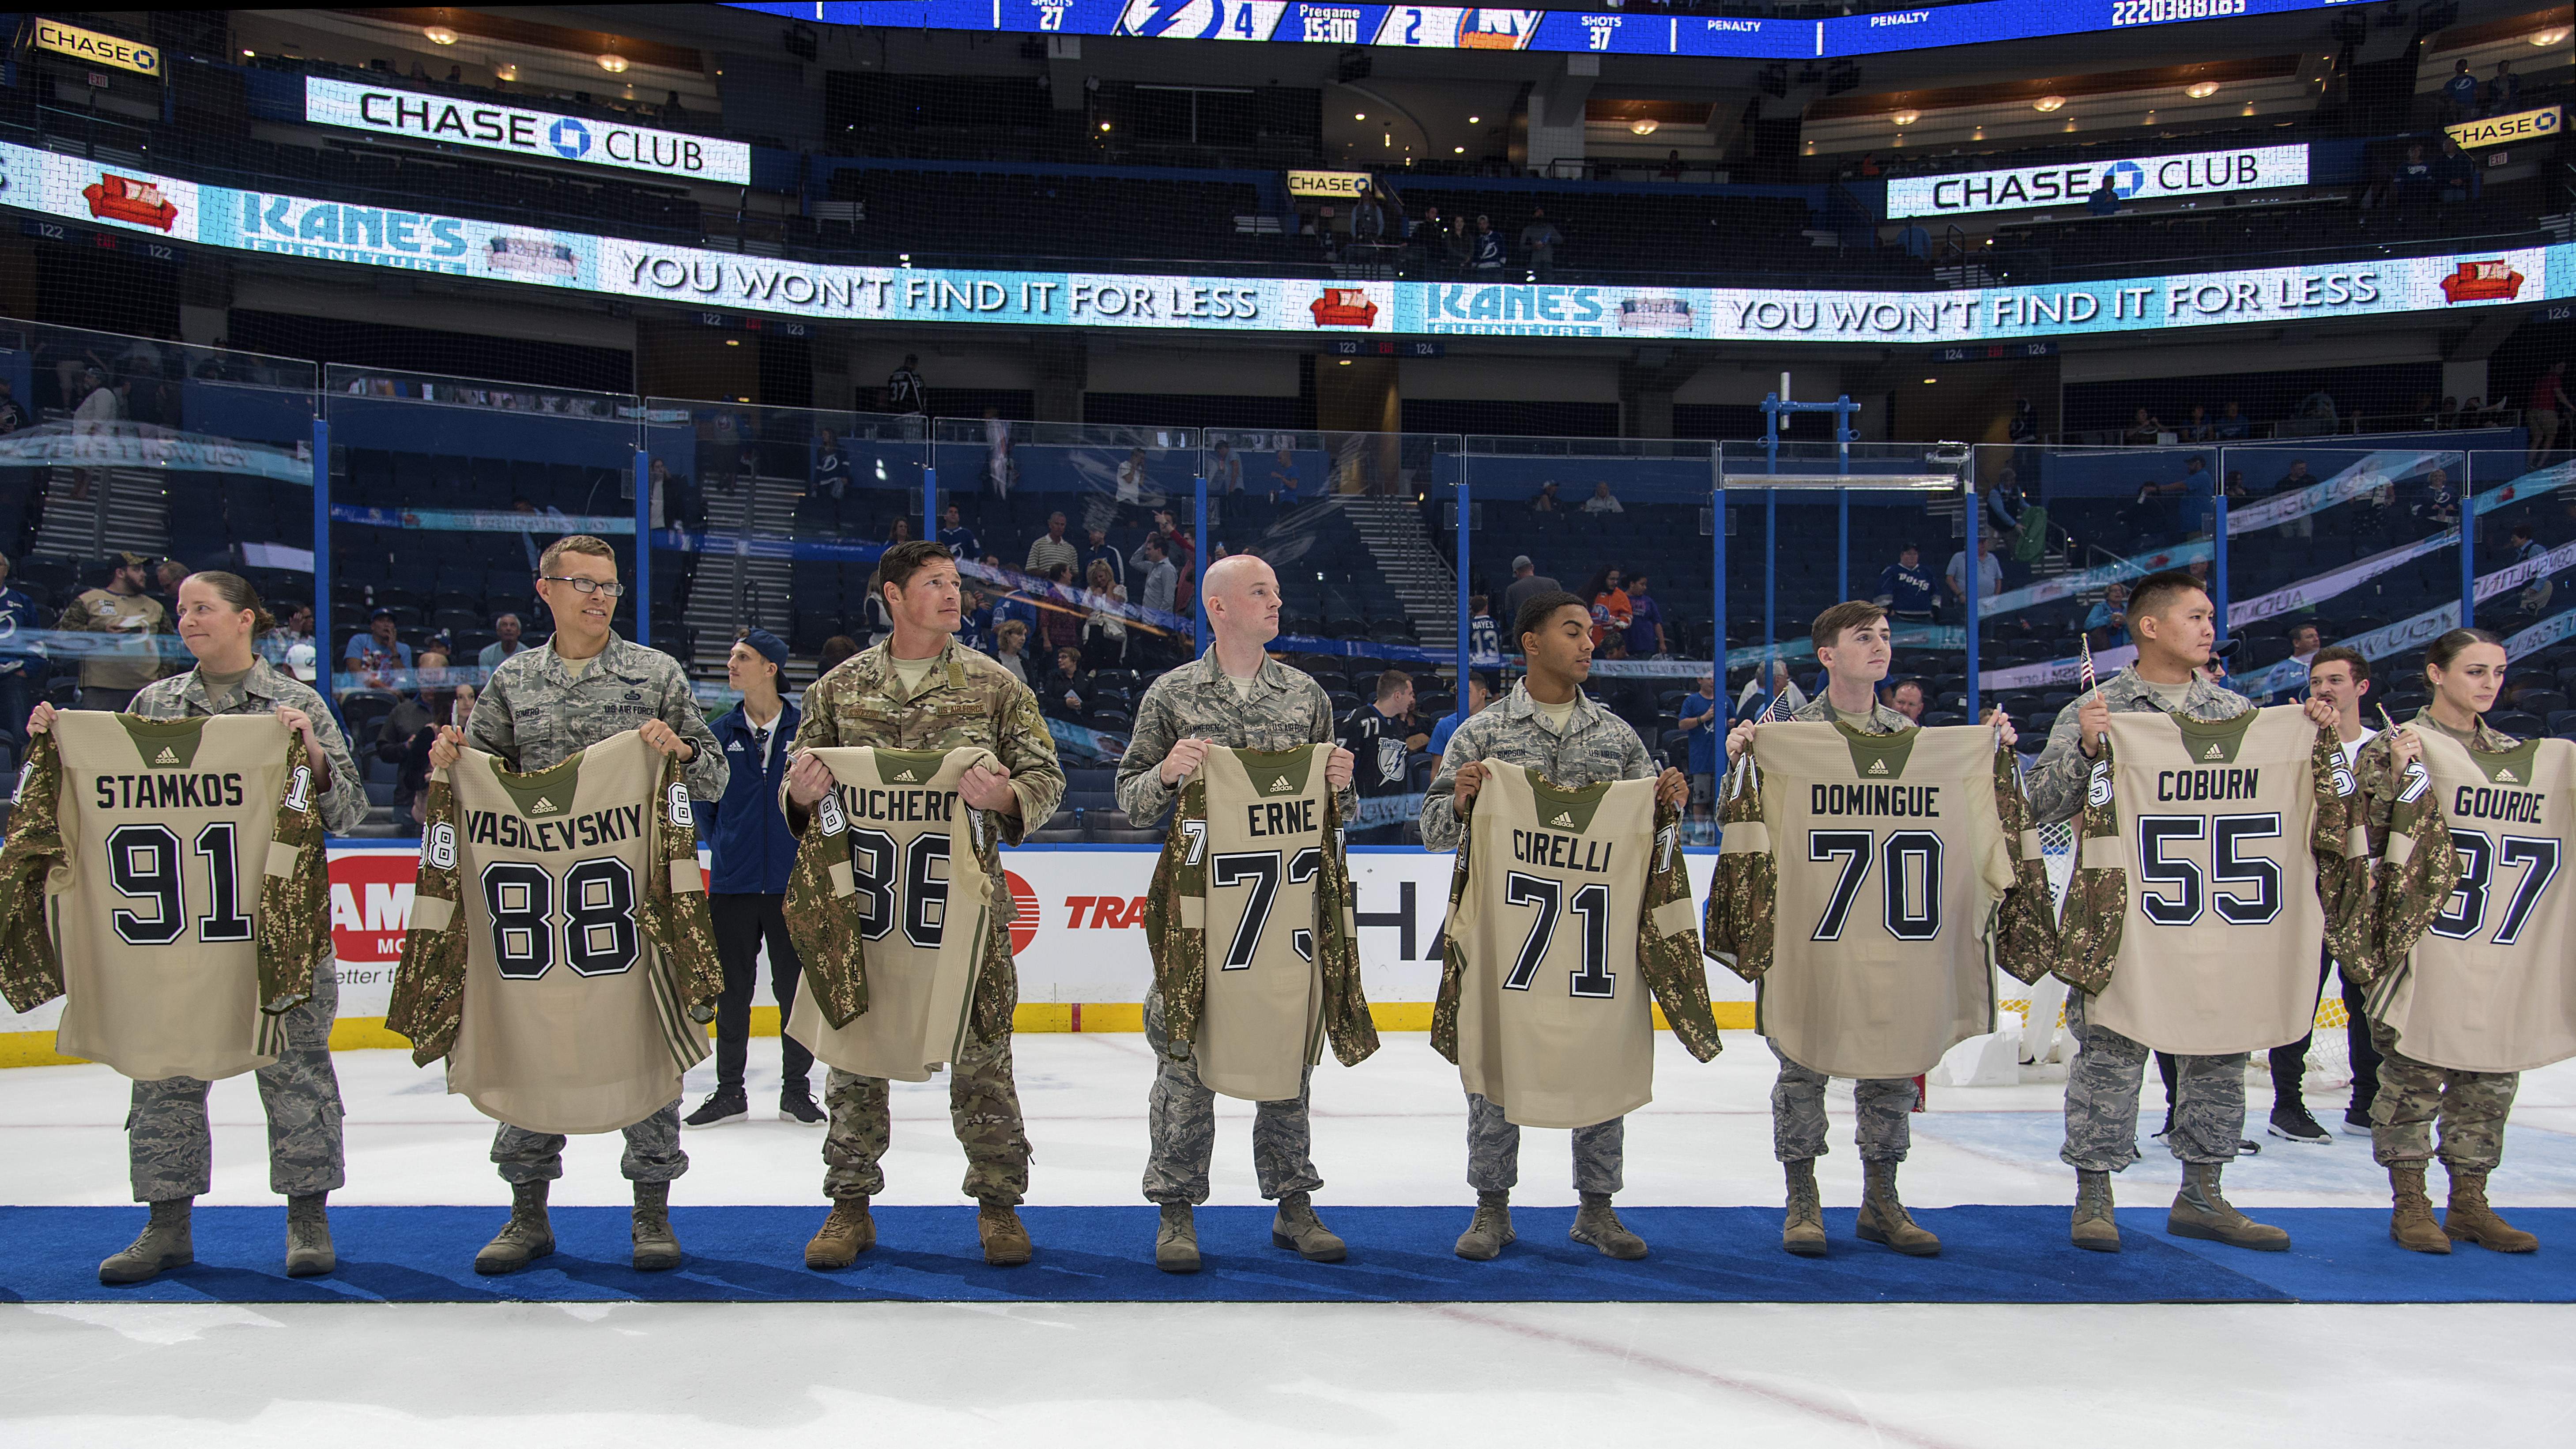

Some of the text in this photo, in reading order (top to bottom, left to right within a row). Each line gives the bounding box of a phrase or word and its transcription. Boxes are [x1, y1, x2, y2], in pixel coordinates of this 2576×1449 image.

[1040, 6, 1064, 30] 27
[1235, 2, 1253, 38] 4
[1300, 4, 1360, 20] Pregame
[1406, 8, 1421, 44] 2
[1581, 16, 1622, 26] SHOTS
[1708, 20, 1761, 32] PENALTY
[1871, 11, 1929, 27] PENALTY
[1303, 17, 1357, 43] 15:00
[1479, 9, 1537, 49] NY
[1589, 26, 1611, 50] 37
[40, 27, 130, 63] CHASE
[91, 74, 107, 87] EXIT
[361, 92, 702, 171] CHASE CLUB
[2491, 154, 2506, 166] EXIT
[1290, 177, 1352, 191] CHASE
[1934, 155, 2257, 209] CHASE CLUB
[39, 223, 63, 238] 122
[244, 192, 467, 257] KANE'S
[151, 245, 171, 260] 122
[253, 240, 460, 275] FURNITURE
[622, 254, 1257, 318] YOU WON'T FIND IT FOR LESS
[1428, 284, 1603, 321] KANE'S
[1733, 272, 2378, 331] YOU WON'T FIND IT FOR LESS
[2547, 307, 2570, 320] 126
[703, 313, 721, 326] 122
[786, 323, 804, 336] 123
[1434, 325, 1591, 336] FURNITURE
[1339, 343, 1356, 353] 123
[1416, 344, 1433, 354] 124
[1946, 349, 1963, 360] 124
[2028, 343, 2046, 355] 126
[890, 381, 909, 400] 37
[1472, 620, 1494, 630] HAYES
[1471, 630, 1499, 658] 13
[516, 708, 539, 719] SOMERO
[633, 706, 654, 716] FORCE
[950, 706, 962, 714] AIR
[963, 705, 984, 713] FORCE
[1185, 723, 1219, 734] HAMMEREN
[1285, 724, 1294, 732] AIR
[1294, 724, 1309, 734] FORCE
[1360, 717, 1379, 738] 77
[1380, 740, 1393, 749] TAMPA
[1497, 749, 1525, 758] SIMPSON
[11, 762, 34, 807] 1
[285, 765, 311, 813] 1
[1270, 784, 1293, 793] adidas
[2087, 760, 2112, 806] 5
[2158, 769, 2259, 801] COBURN
[2329, 752, 2356, 797] 5
[2397, 762, 2429, 803] 7
[96, 773, 243, 809] STAMKOS
[668, 782, 694, 828] 8
[1812, 784, 1939, 817] DOMINGUE
[2453, 785, 2544, 824] GOURDE
[532, 804, 558, 814] adidas
[818, 790, 845, 837] 8
[1248, 799, 1317, 837] ERNE
[1550, 818, 1574, 828] adidas
[465, 804, 641, 852] VASILEVSKIY
[1183, 820, 1208, 867] 7
[1513, 829, 1613, 873] CIRELLI
[1655, 824, 1675, 874] 7
[106, 822, 254, 945] 91
[2138, 812, 2282, 926] 55
[846, 823, 950, 949] 86
[1808, 830, 1944, 941] 70
[2428, 827, 2561, 945] 87
[480, 856, 641, 980] 88
[1502, 870, 1616, 999] 71
